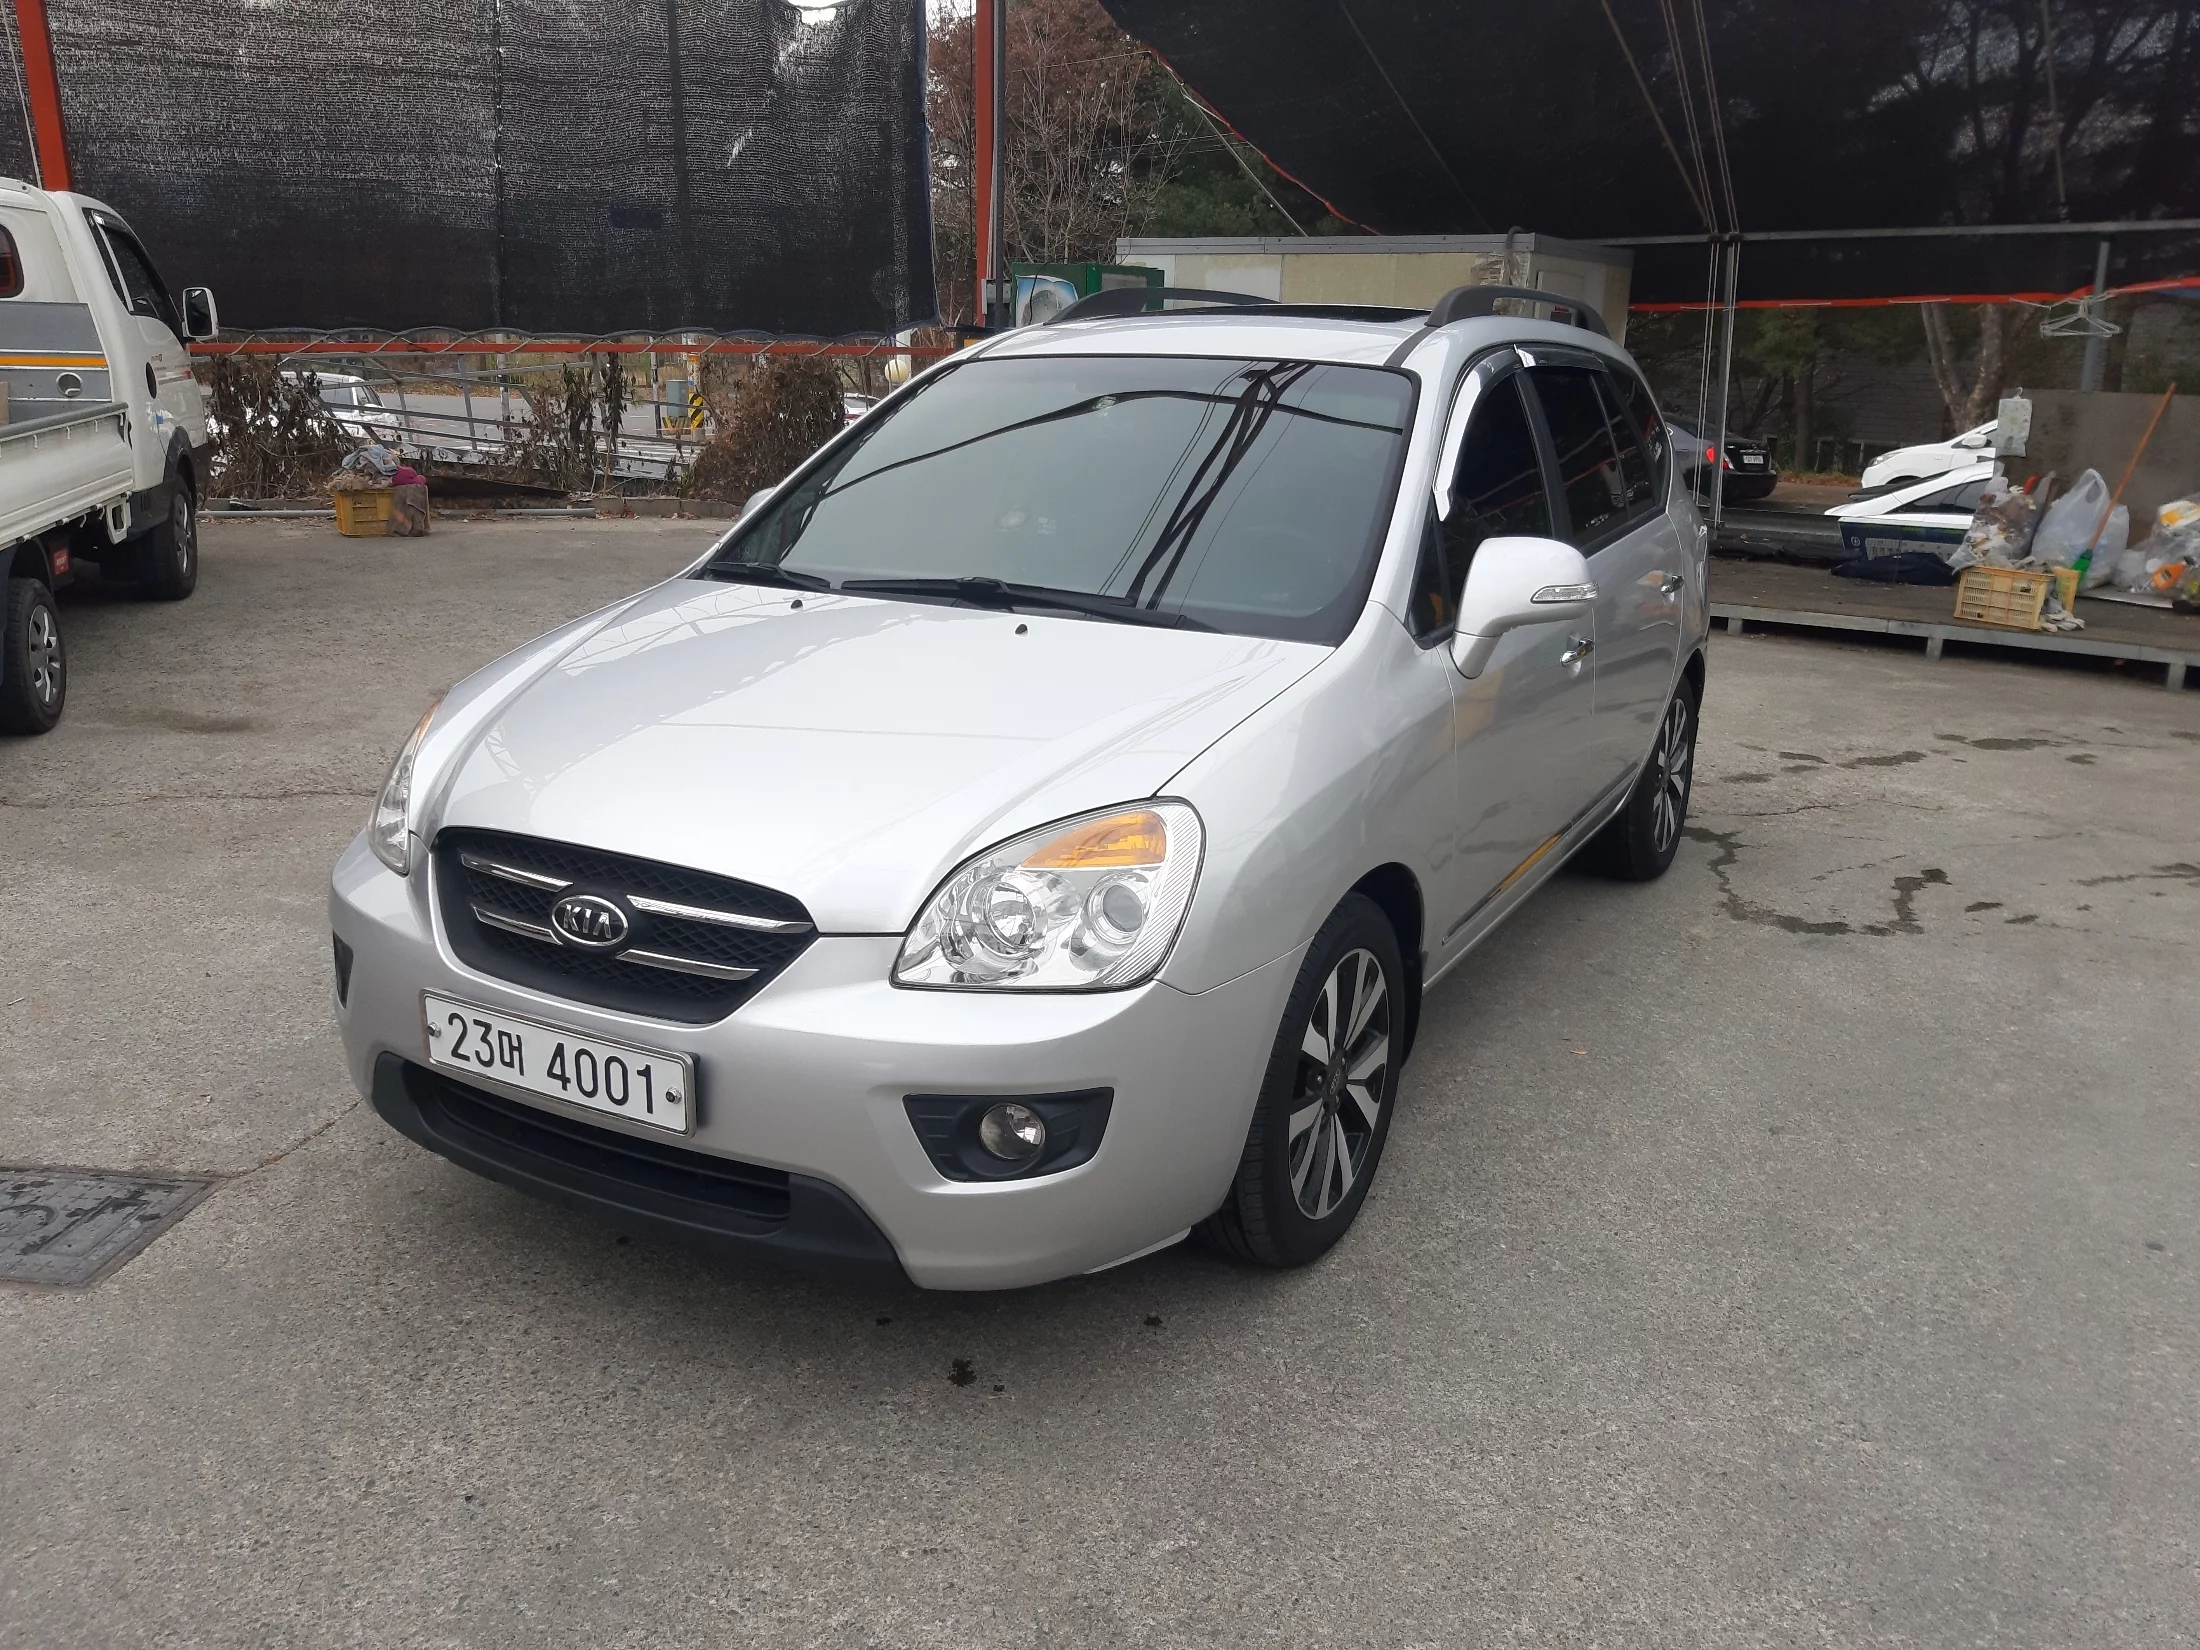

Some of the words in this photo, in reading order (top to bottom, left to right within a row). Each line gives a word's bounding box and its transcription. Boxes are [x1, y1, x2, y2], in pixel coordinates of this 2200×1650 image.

[563, 903, 612, 939] KIA
[448, 1012, 525, 1077] 23머
[546, 1042, 654, 1115] 4001
